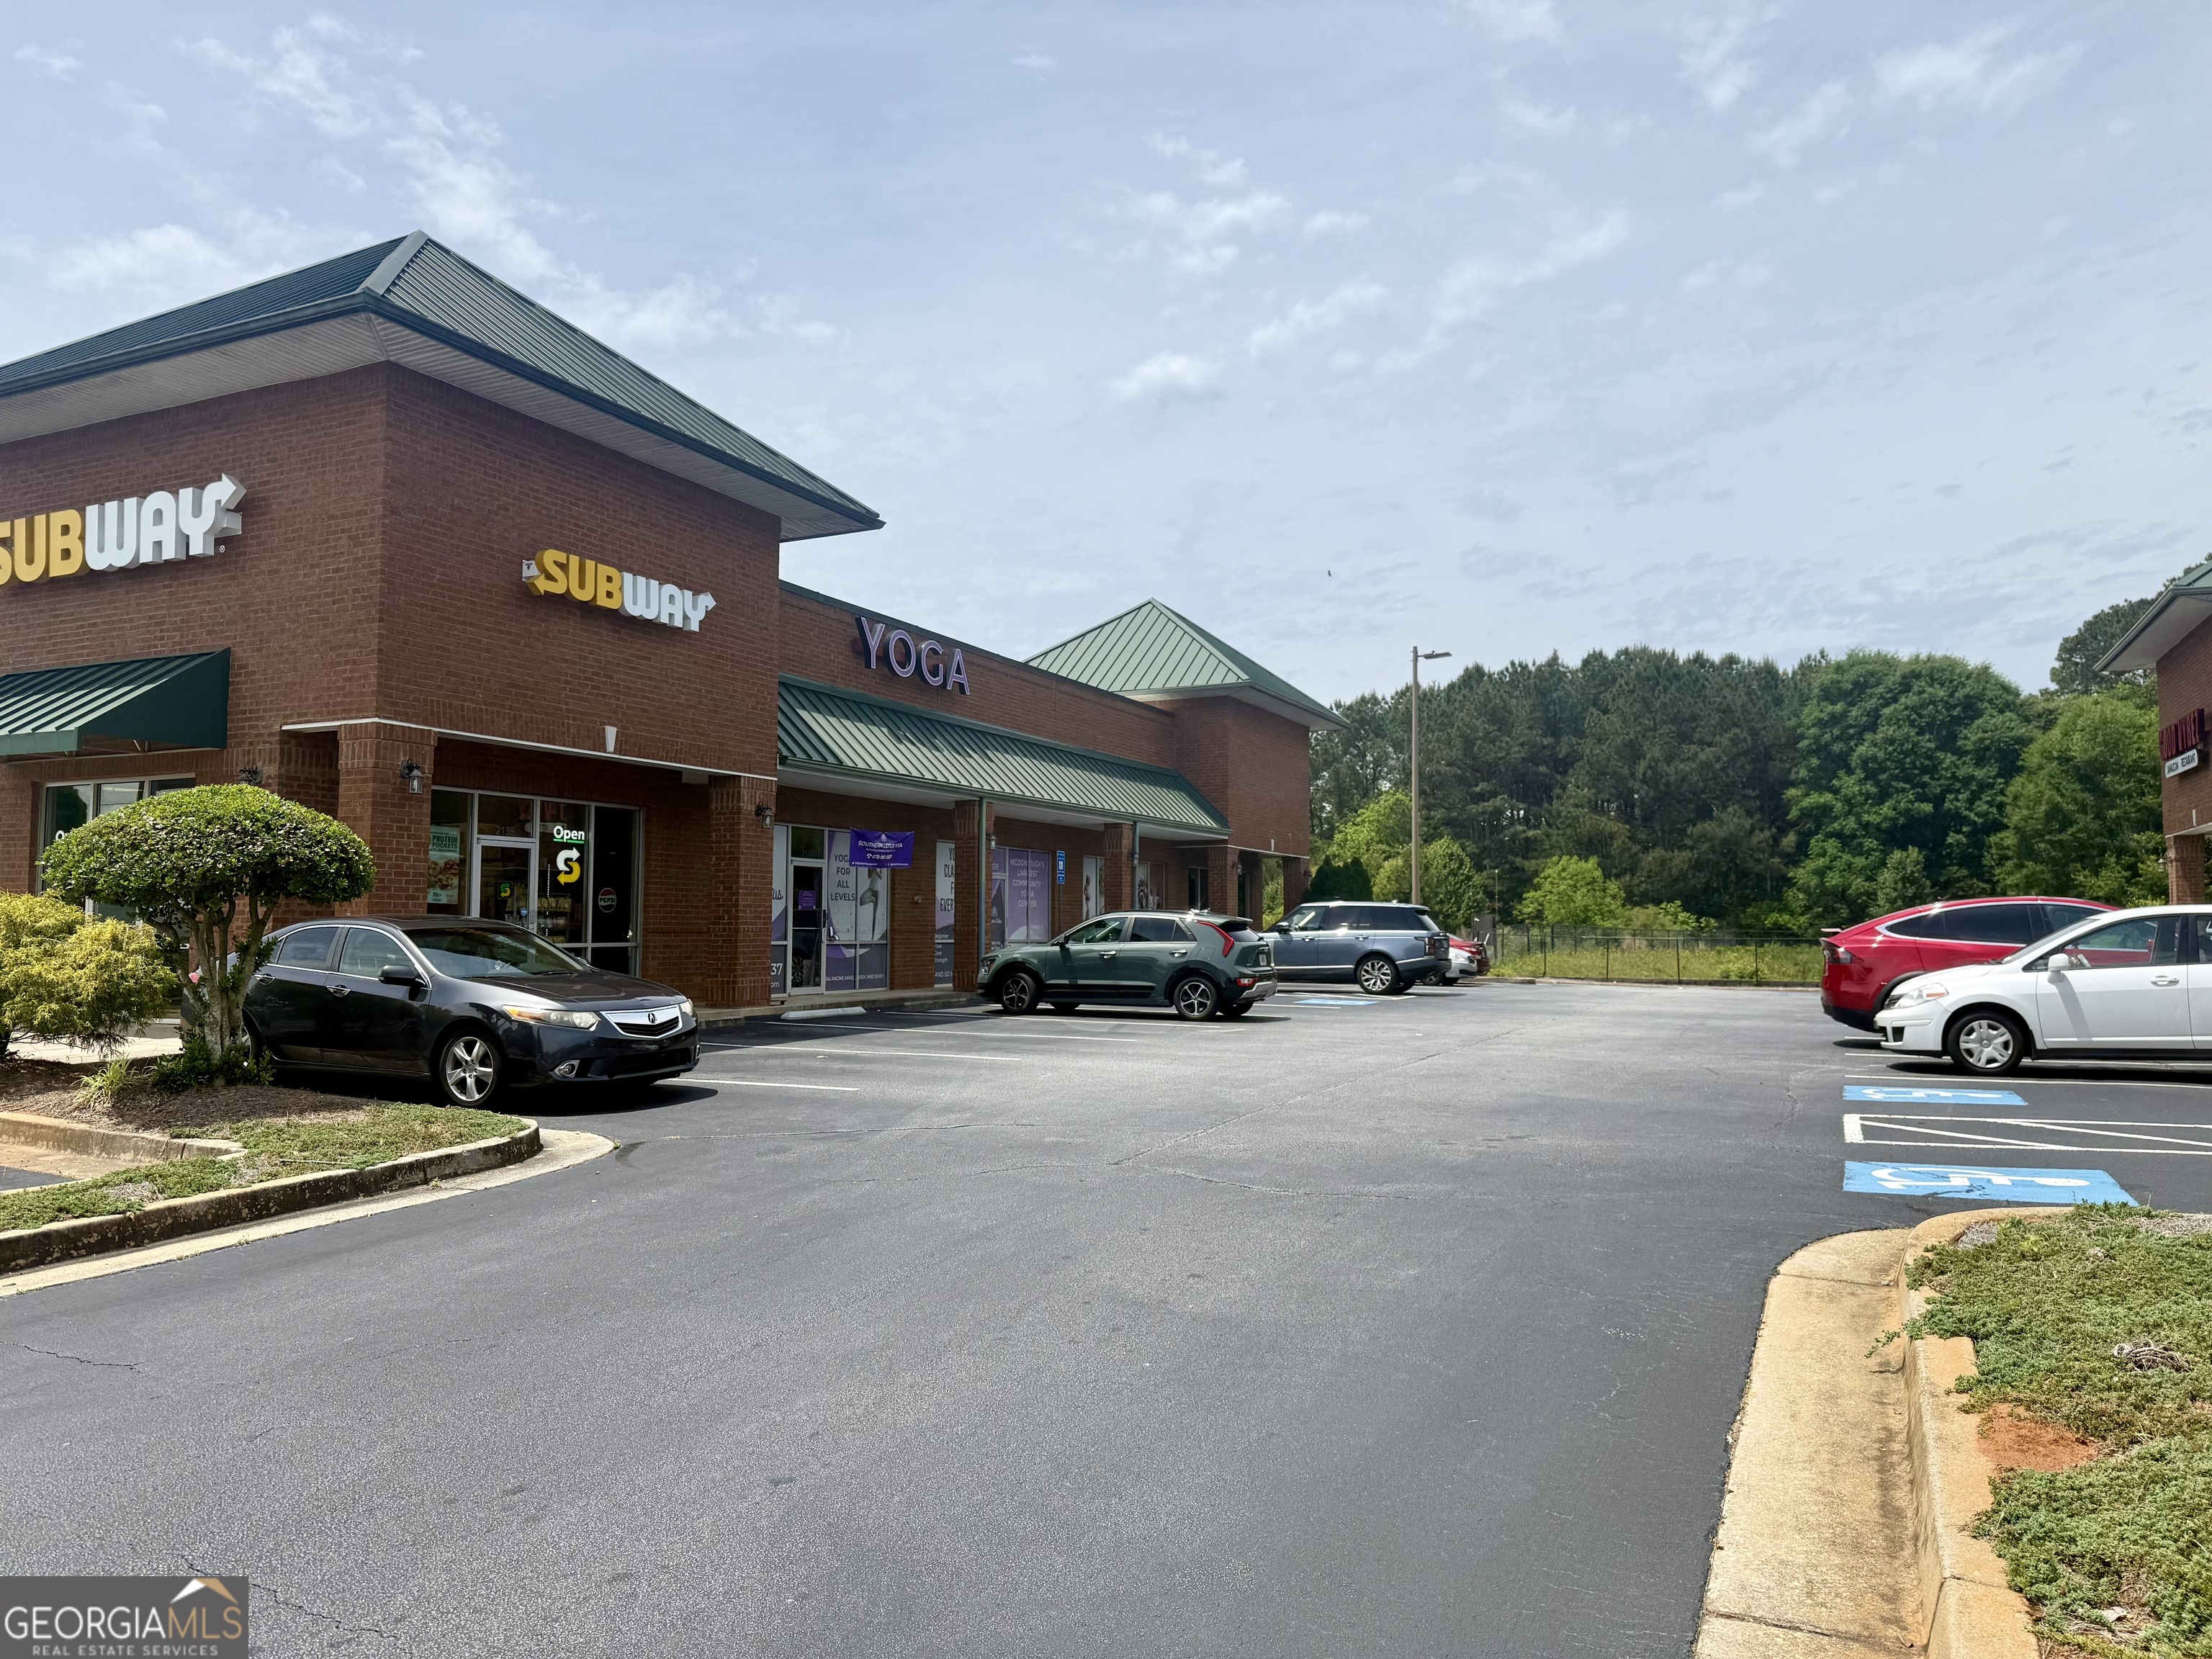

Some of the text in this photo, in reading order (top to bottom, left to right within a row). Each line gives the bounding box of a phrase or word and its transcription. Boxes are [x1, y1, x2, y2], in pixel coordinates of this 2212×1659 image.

[527, 549, 717, 632] SUBWAY
[855, 616, 971, 696] YOGA
[495, 826, 515, 836] 2135
[553, 825, 585, 842] Open
[432, 835, 458, 844] PROTEIN
[858, 840, 883, 849] SOUTHERN
[834, 854, 850, 863] YOG
[836, 867, 850, 876] FOR
[1017, 869, 1038, 878] LAREST
[837, 880, 850, 889] ALL
[772, 888, 784, 900] us
